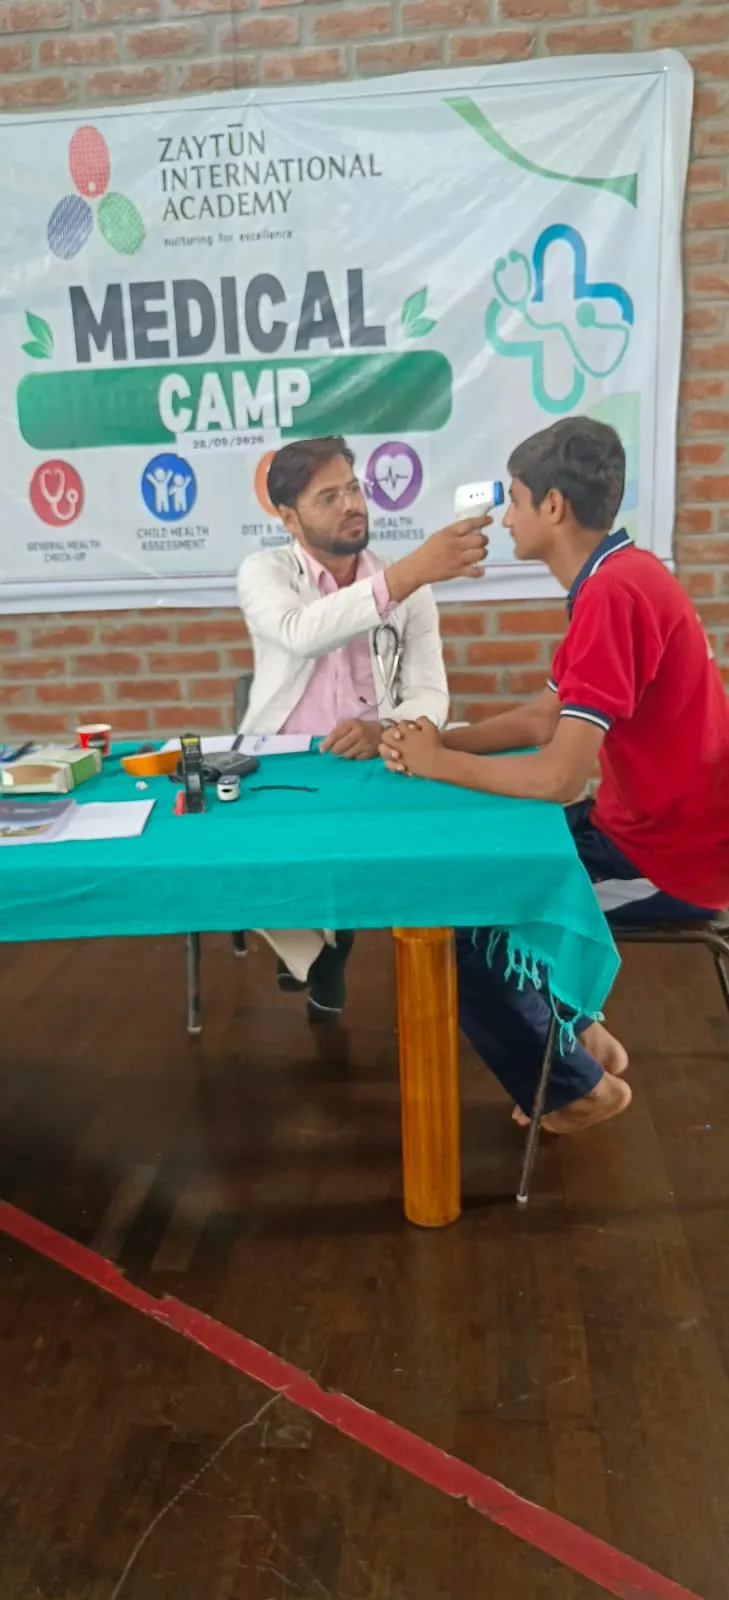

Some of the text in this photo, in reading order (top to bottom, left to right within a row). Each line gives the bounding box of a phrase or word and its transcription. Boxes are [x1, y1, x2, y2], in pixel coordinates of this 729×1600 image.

[158, 123, 266, 162] ZAYTŪN
[160, 153, 383, 192] INTERNATIONAL
[162, 189, 293, 222] ACADEMY
[163, 229, 293, 248] nurturing for excellence
[69, 268, 387, 363] MEDICAL
[158, 368, 312, 433] CAMP
[136, 525, 209, 539] CHILD HEALTH
[372, 516, 413, 529] HEALTH
[367, 528, 425, 541] WARENESS
[66, 539, 101, 550] HEALTH
[141, 538, 206, 551] ASSESSMENT
